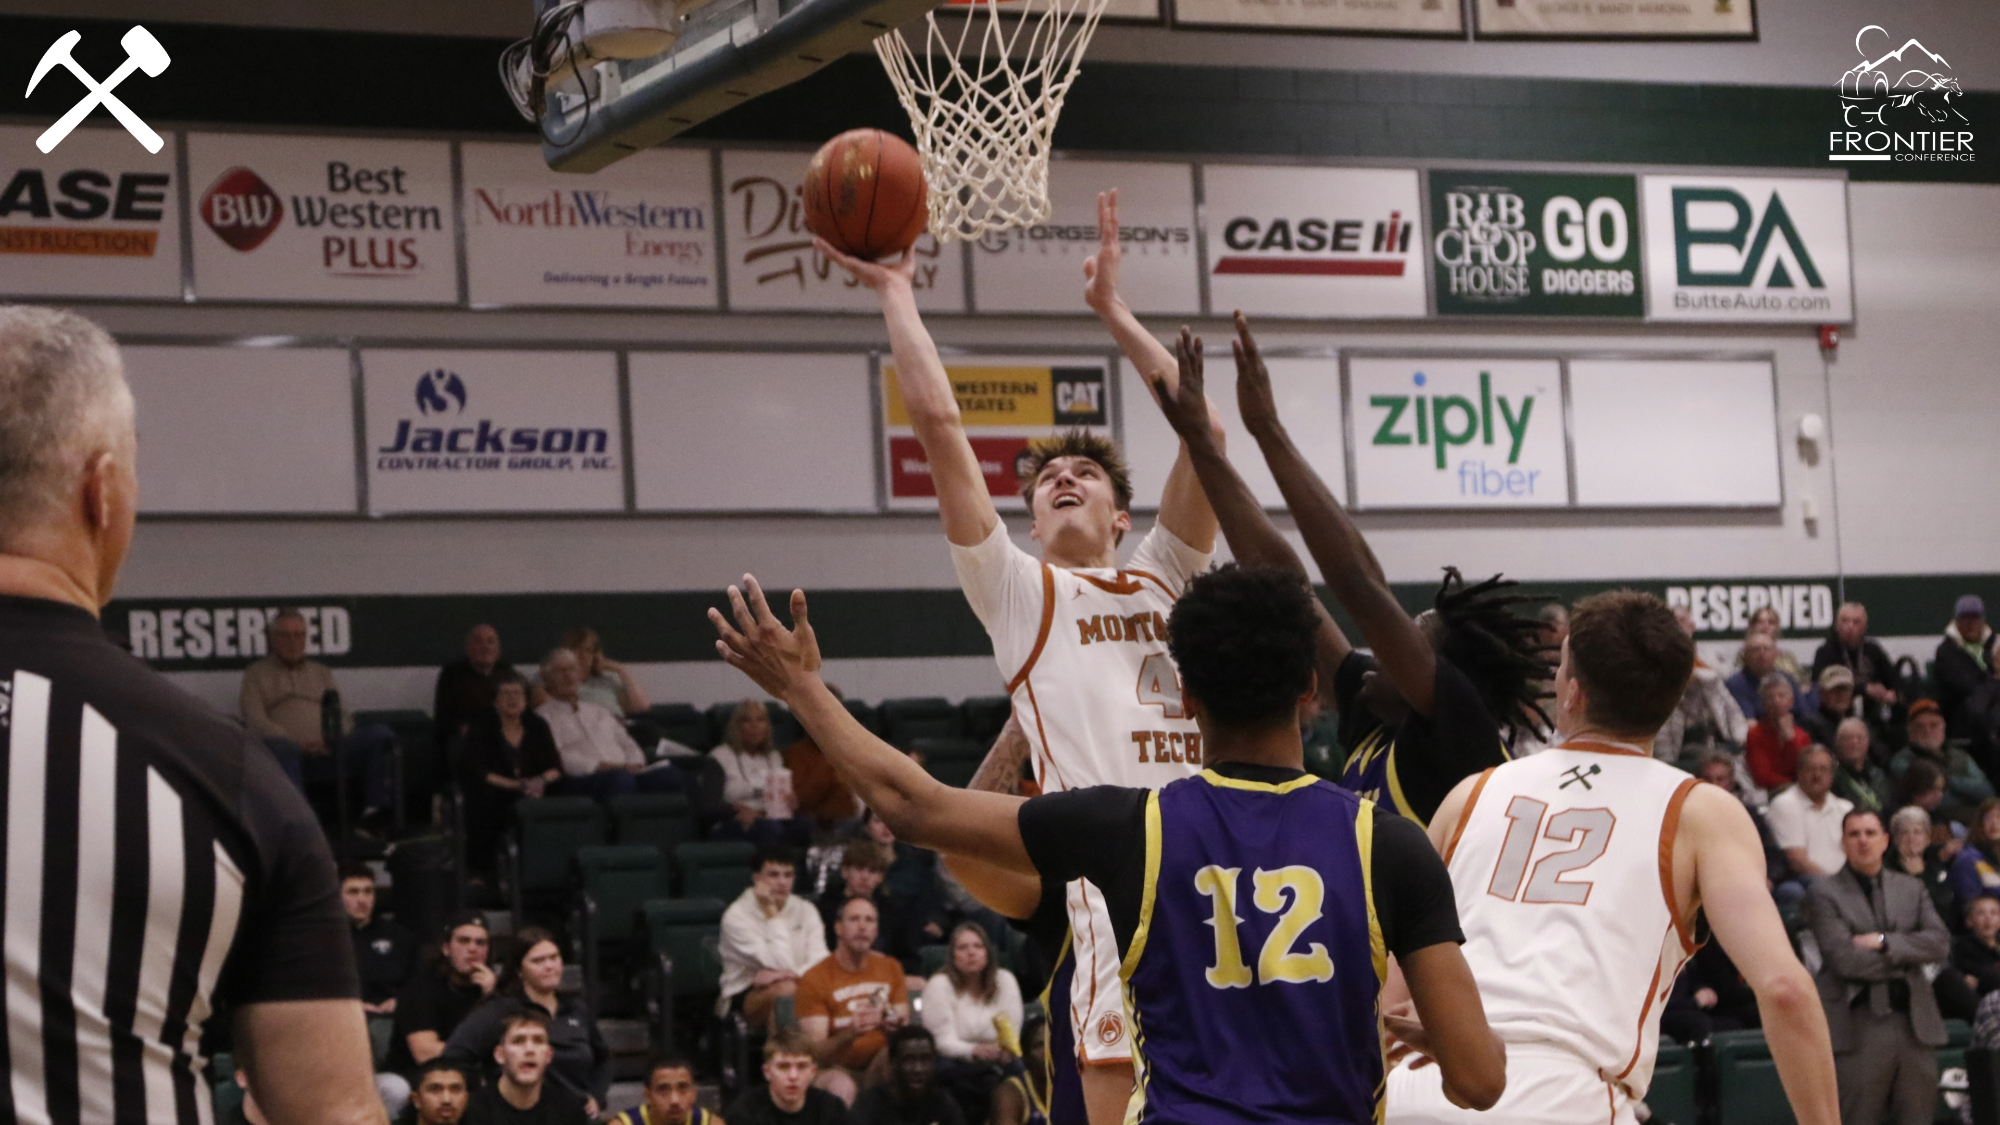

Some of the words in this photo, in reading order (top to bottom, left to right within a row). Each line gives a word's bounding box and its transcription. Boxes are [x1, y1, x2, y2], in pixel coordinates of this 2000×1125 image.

[327, 161, 407, 195] Best
[211, 193, 275, 228] BW
[292, 195, 442, 230] Western
[474, 187, 705, 230] NorthWestern
[1013, 223, 1190, 243] TORGESON'S
[1223, 217, 1364, 252] CASE
[1542, 195, 1629, 263] GO
[1671, 186, 1827, 289] BA
[323, 236, 418, 269] PLUS
[625, 231, 704, 265] Energy
[1435, 229, 1537, 267] CHOP
[543, 271, 609, 287] Delivering
[624, 273, 664, 287] Bright
[668, 274, 708, 286] Future
[1449, 266, 1530, 297] HOUSE
[1541, 268, 1635, 296] DIGGERS
[1674, 293, 1831, 312] ButteAuto.com
[954, 381, 1038, 395] WESTERN
[1056, 381, 1102, 413] CAT
[379, 418, 608, 454] Jackson
[1370, 370, 1536, 470] ziply
[377, 456, 500, 471] CONTRACTOR
[507, 457, 574, 472] GROUP,
[582, 458, 616, 471] INC.
[1458, 459, 1541, 497] fiber
[1076, 611, 1169, 645] MONTA
[1136, 652, 1184, 719] 4
[1132, 731, 1202, 765] TECH
[1487, 795, 1617, 906] 12
[1194, 864, 1335, 990] 12
